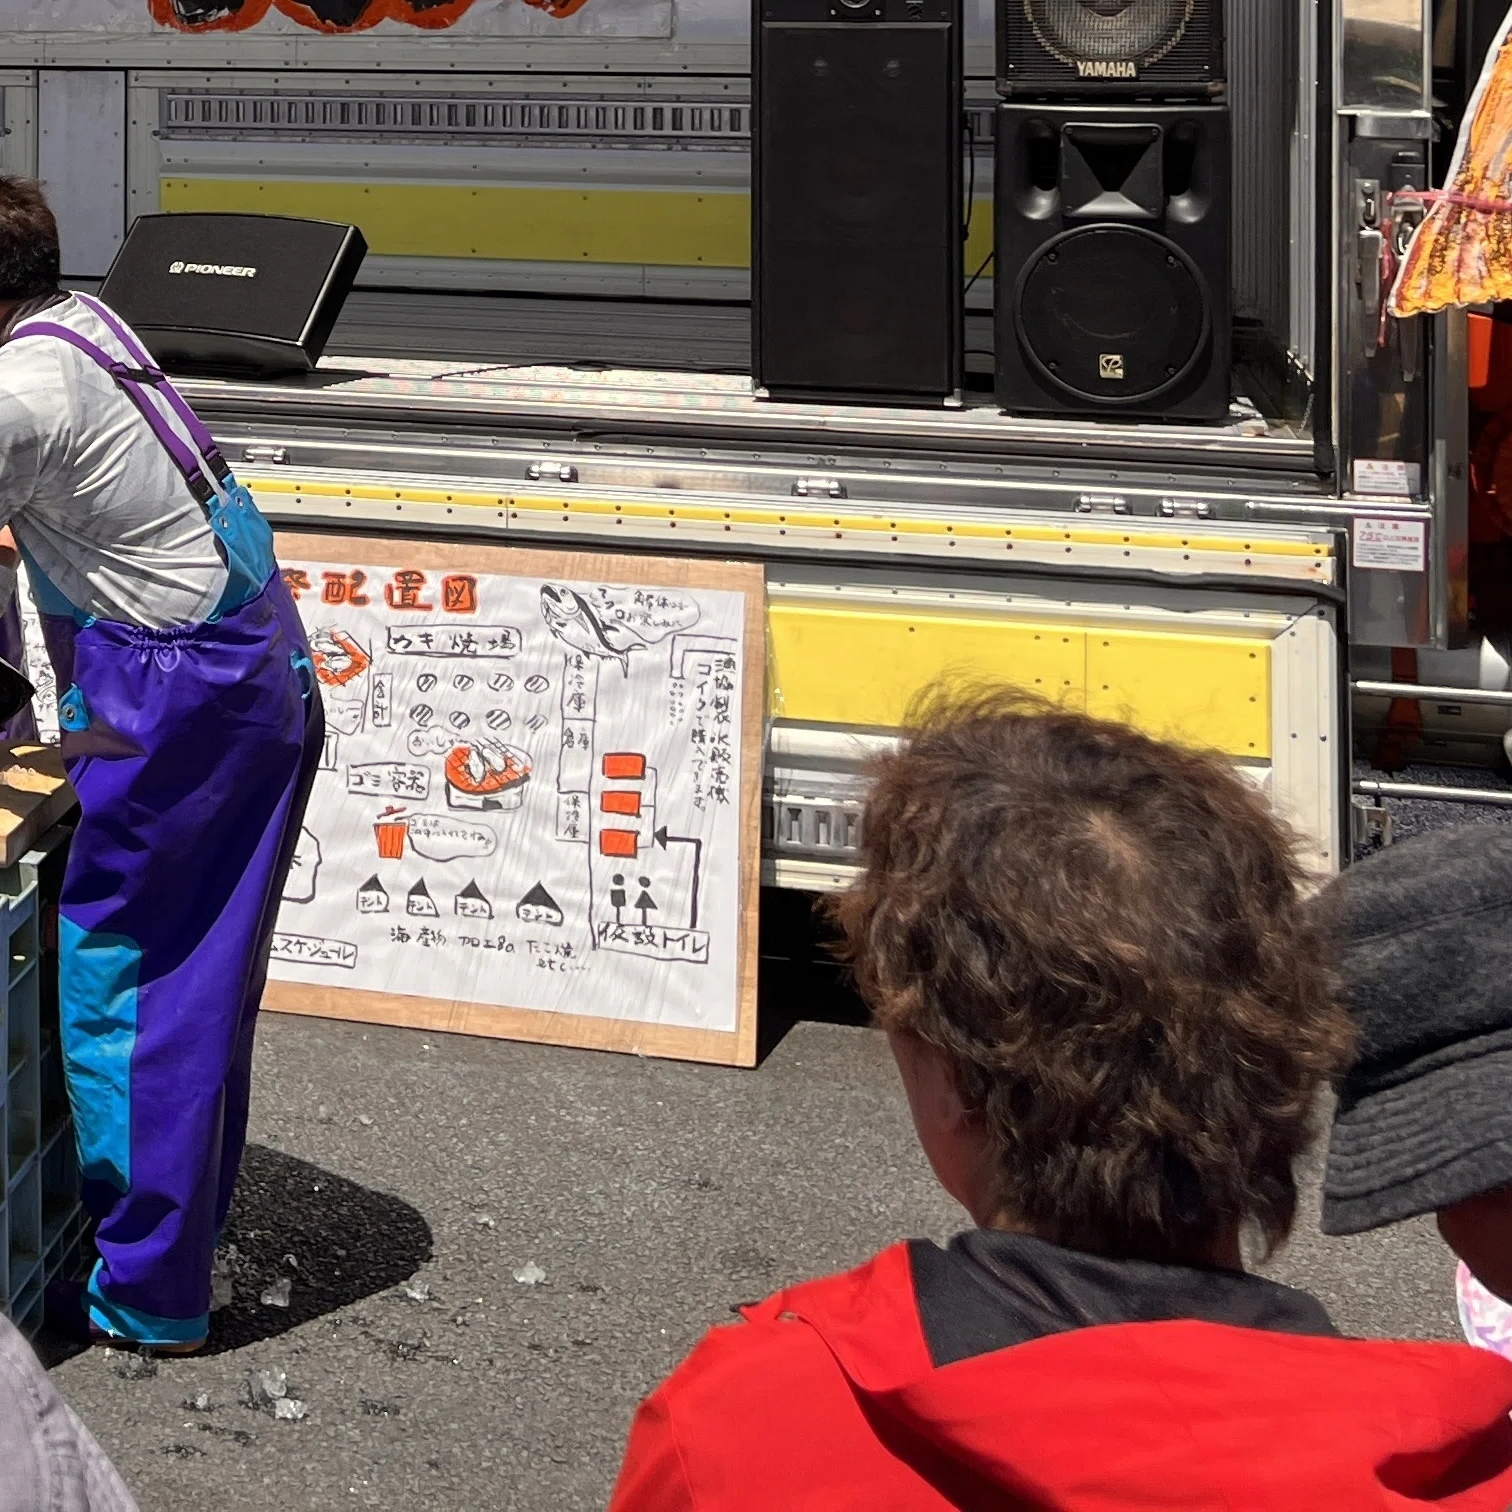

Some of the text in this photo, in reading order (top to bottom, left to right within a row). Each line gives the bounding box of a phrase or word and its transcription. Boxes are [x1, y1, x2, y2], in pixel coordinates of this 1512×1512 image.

[1076, 61, 1137, 77] YAMAHA
[184, 263, 257, 278] PIONEER
[360, 896, 383, 908] テント
[409, 899, 434, 912] テント
[459, 903, 487, 915] テント
[598, 921, 707, 955] 仮設トイレ
